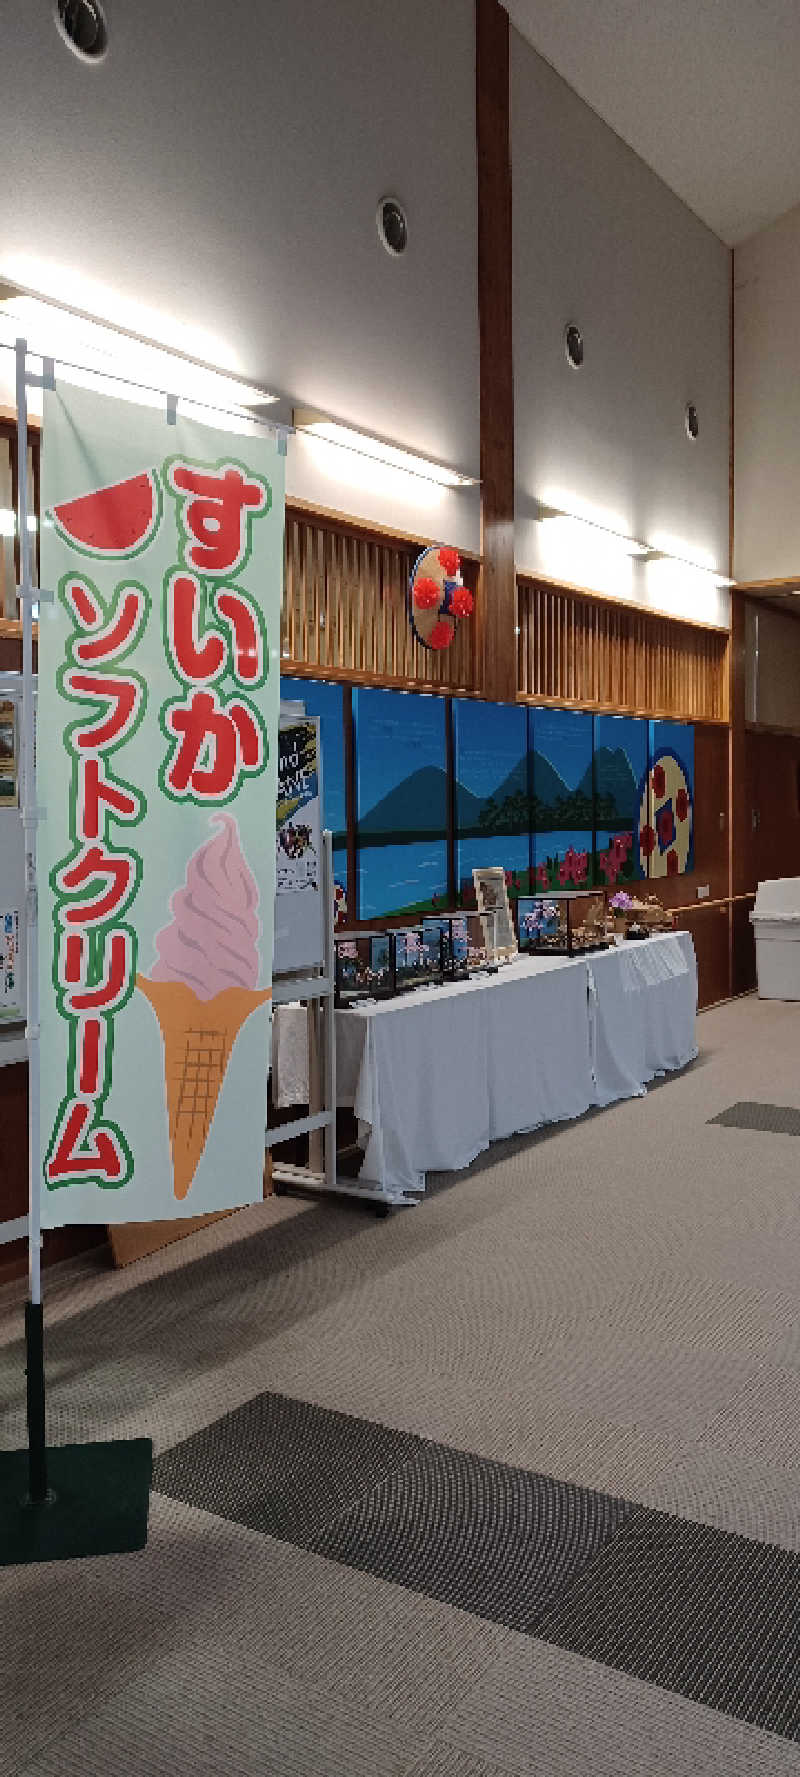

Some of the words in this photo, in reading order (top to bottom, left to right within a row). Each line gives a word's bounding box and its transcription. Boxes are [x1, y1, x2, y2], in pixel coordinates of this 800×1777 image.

[163, 458, 269, 803] すいか
[46, 575, 149, 1190] ソフトクリーム
